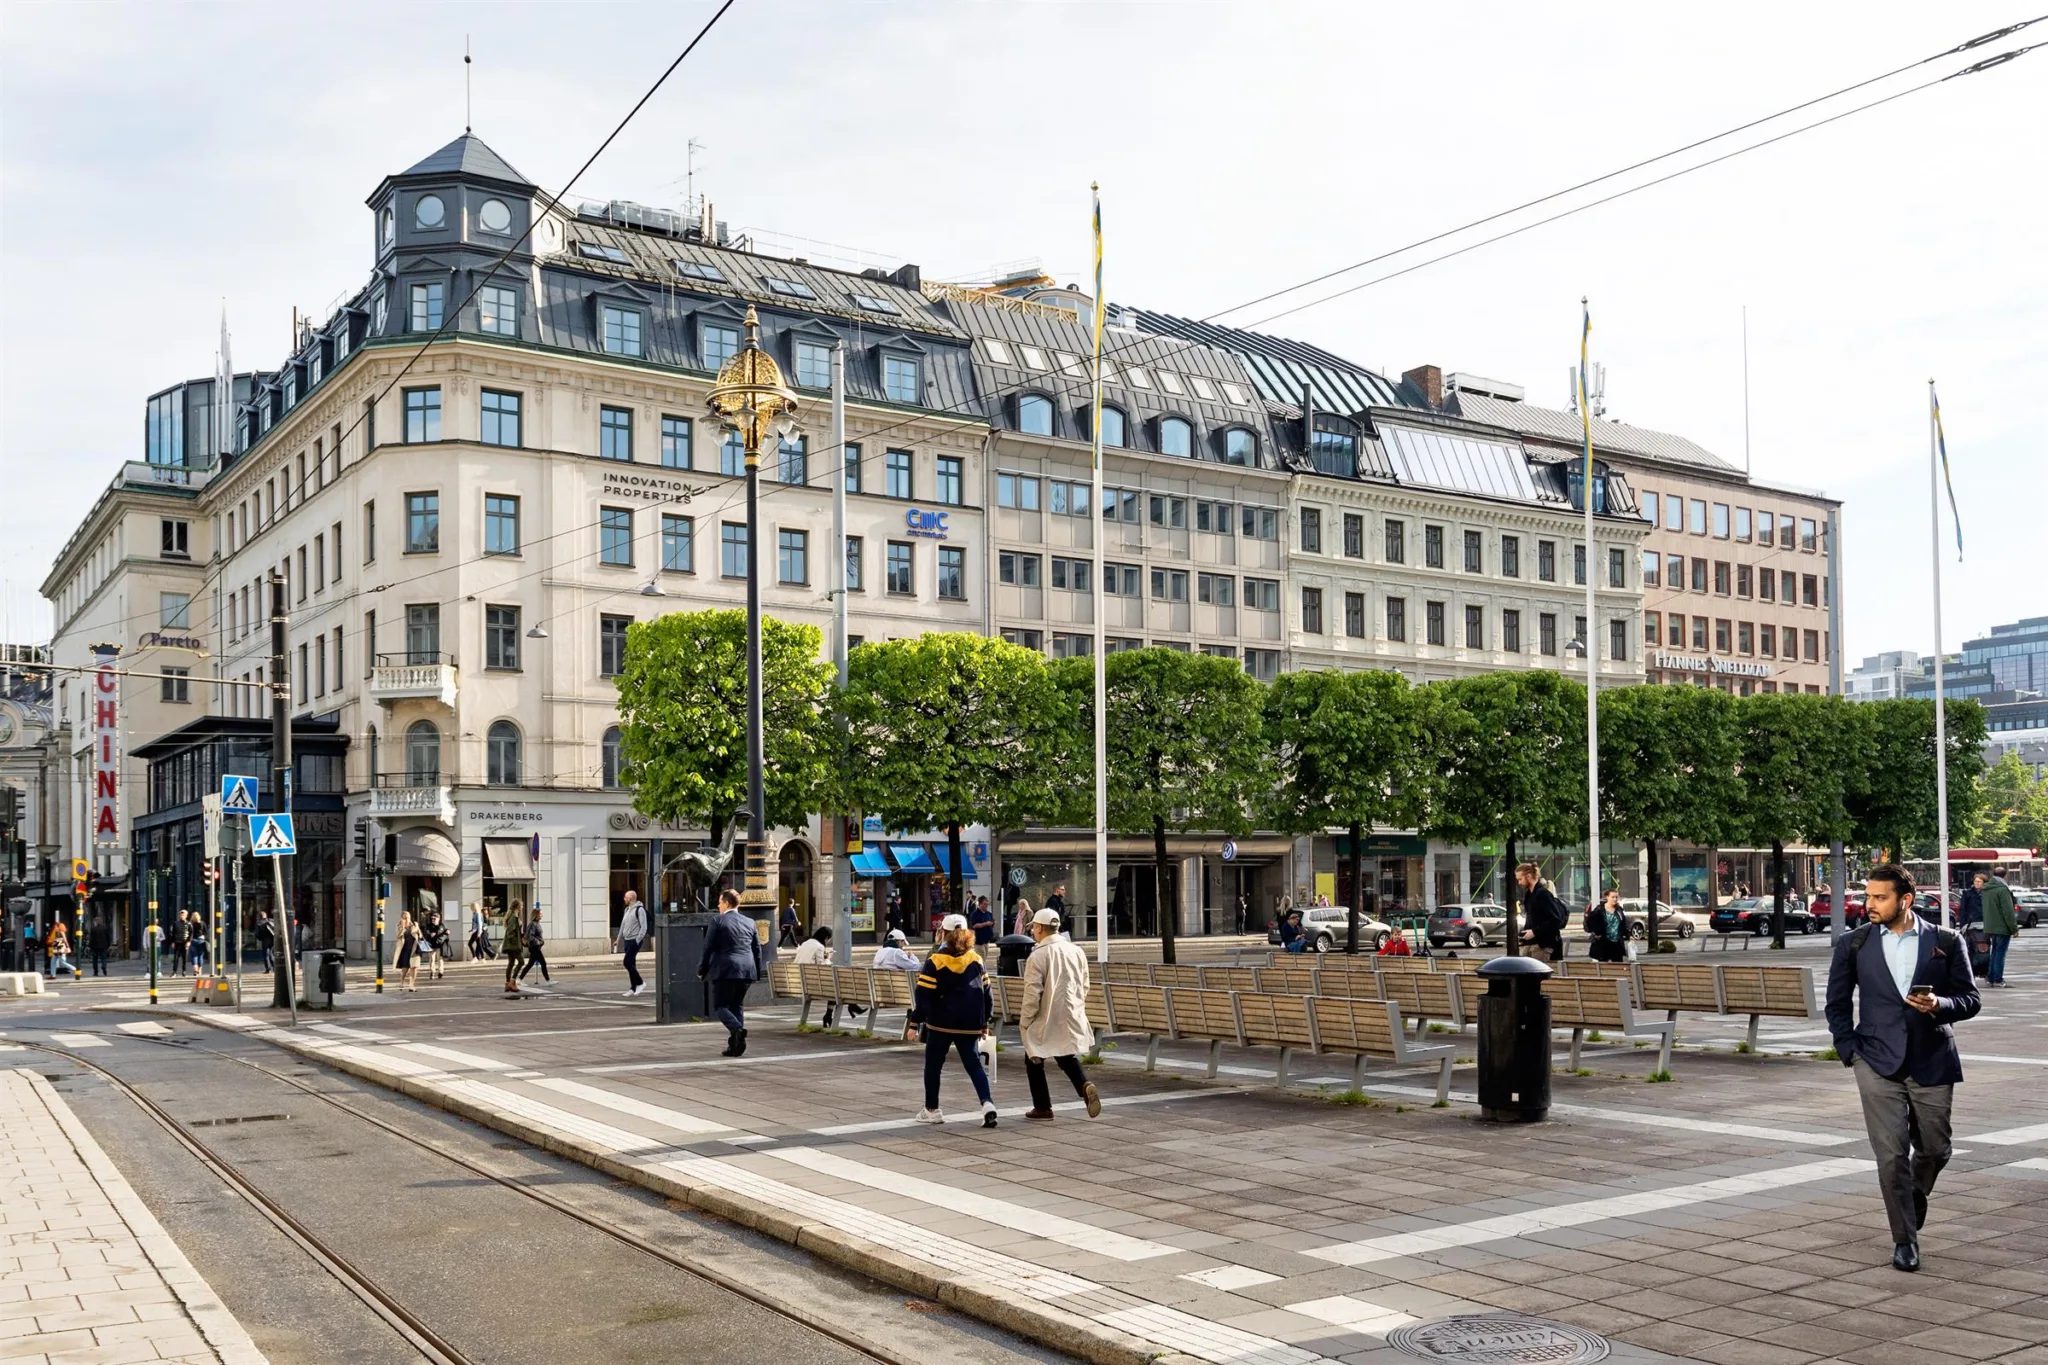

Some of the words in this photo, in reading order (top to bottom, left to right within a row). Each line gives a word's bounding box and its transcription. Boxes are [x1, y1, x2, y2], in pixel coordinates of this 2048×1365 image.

[604, 473, 691, 491] INNOVATION
[604, 485, 691, 504] PROPERTIES
[147, 632, 200, 649] Pareto
[1655, 650, 1708, 672] HANNES
[97, 664, 116, 833] CHINA
[470, 812, 543, 821] DRAKENBERG
